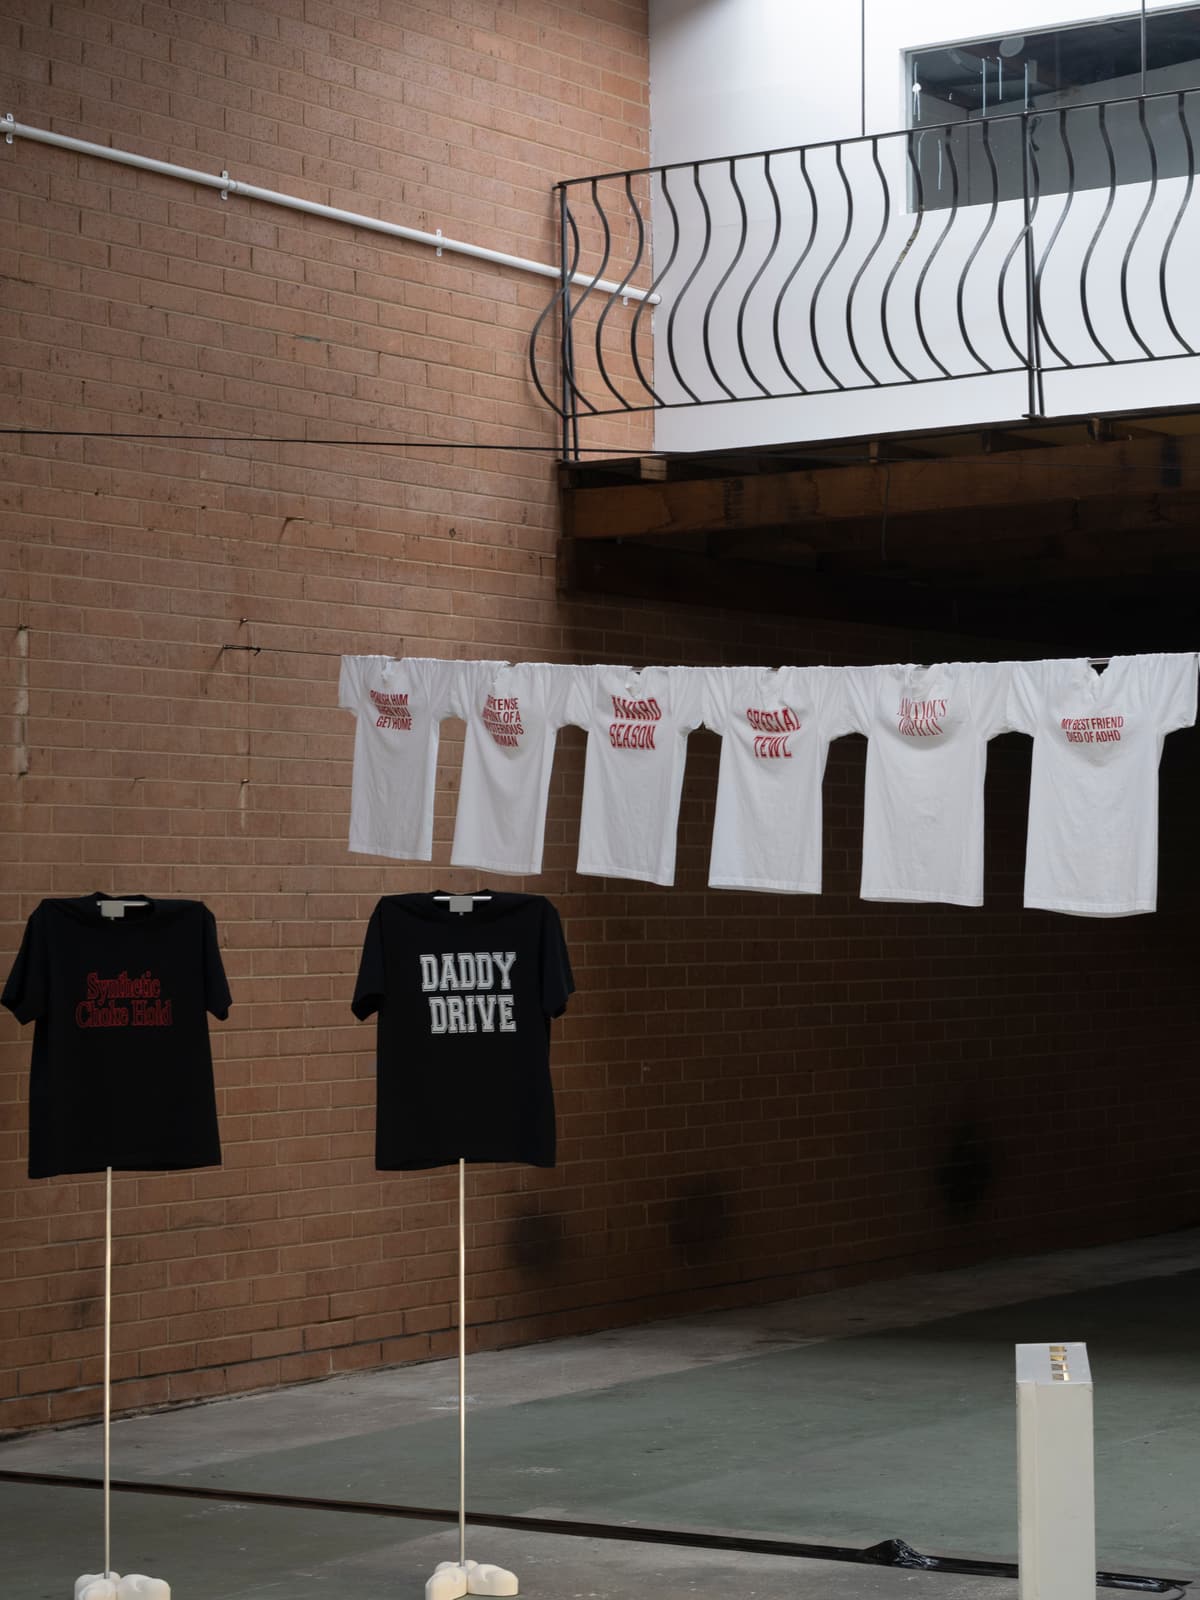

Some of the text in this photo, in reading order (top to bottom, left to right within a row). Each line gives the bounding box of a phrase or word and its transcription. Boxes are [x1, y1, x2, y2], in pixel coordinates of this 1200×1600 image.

[503, 711, 514, 724] OF
[515, 710, 522, 723] A
[611, 695, 662, 721] AWARD
[746, 707, 801, 733] SPECIAL
[376, 715, 412, 731] GET HOME
[1061, 715, 1124, 730] MY BEST FRIEND
[609, 723, 656, 750] SEASON
[1066, 730, 1121, 743] DIED OF ADHD
[419, 951, 517, 993] DADDY
[87, 970, 161, 1006] Synthetic
[75, 999, 173, 1029] Choke Hold
[427, 994, 517, 1034] DRIVE
